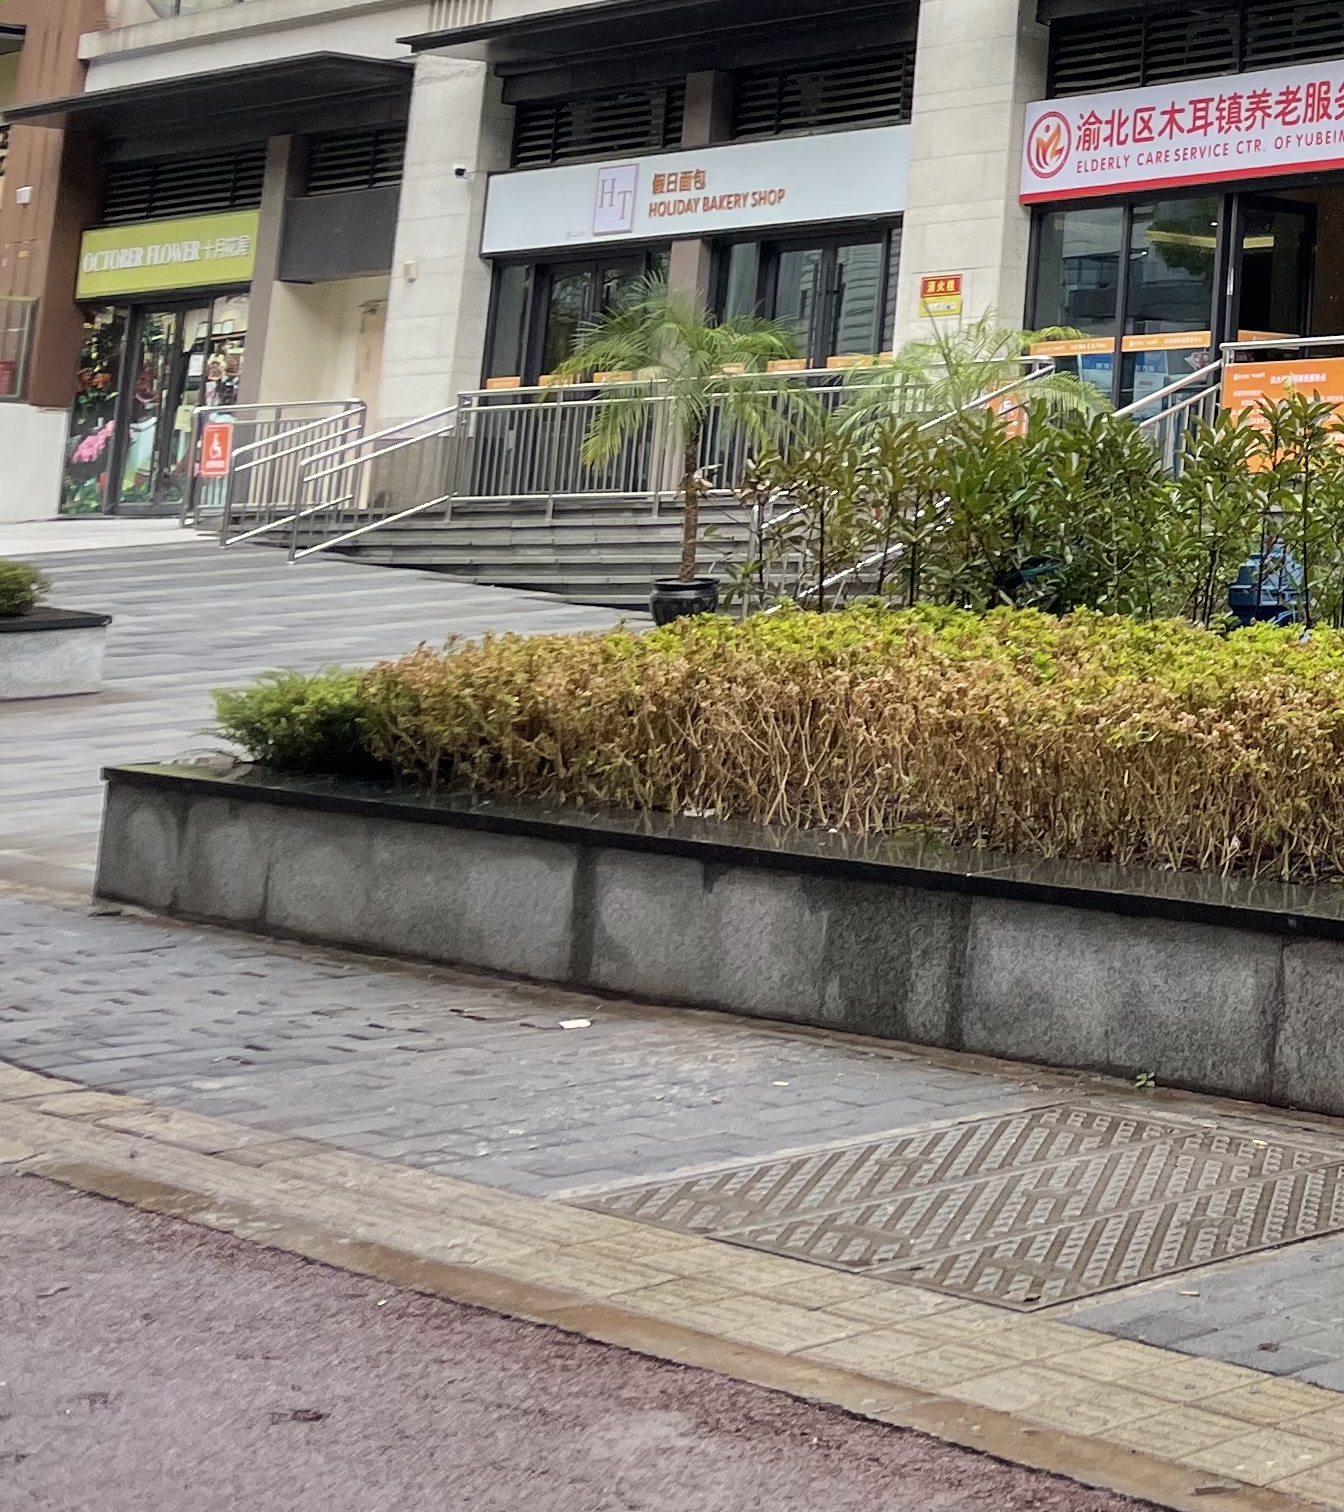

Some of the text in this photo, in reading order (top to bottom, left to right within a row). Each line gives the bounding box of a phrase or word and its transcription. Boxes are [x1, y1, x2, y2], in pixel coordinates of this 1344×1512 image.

[1077, 155, 1130, 174] ELDERLY
[1137, 150, 1170, 166] CARE
[1174, 142, 1229, 162] SERVICE
[1274, 135, 1291, 150] OF
[652, 169, 706, 195] 假日面包
[648, 188, 785, 217] HOLIDAY BAKERY SHOP
[83, 240, 200, 273] OCTOBER FLOWER
